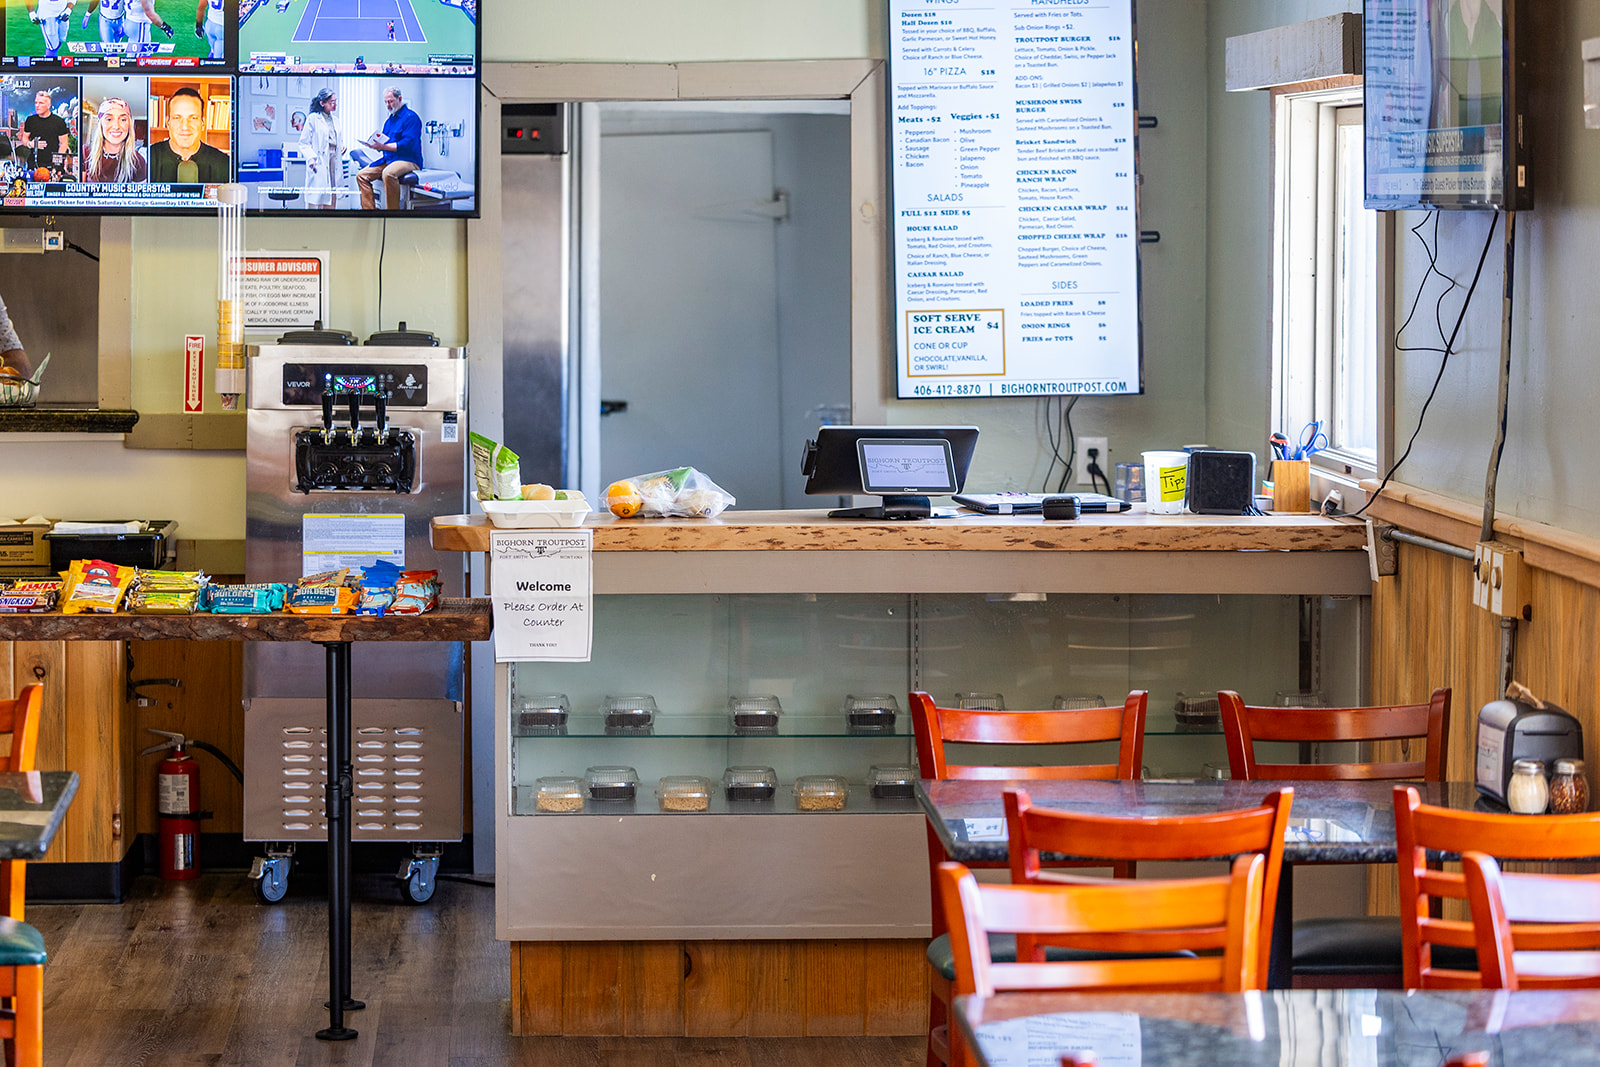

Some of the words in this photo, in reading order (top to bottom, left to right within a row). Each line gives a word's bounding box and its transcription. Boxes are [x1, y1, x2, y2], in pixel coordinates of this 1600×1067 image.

[66, 184, 101, 192] COUNTRY
[102, 184, 125, 192] MUSIC
[127, 184, 171, 193] SUPERSTAR
[928, 193, 963, 202] SALADS
[231, 262, 275, 271] SUMER
[277, 262, 317, 271] ADVISORY
[1052, 281, 1078, 289] SIDES
[914, 385, 981, 395] 406-412-8870
[1002, 382, 1127, 394] BIGHORNTROUTPOST.COM
[1160, 475, 1185, 489] Tips
[516, 581, 571, 591] Welcome
[504, 602, 535, 611] Please
[538, 602, 567, 611] Order
[570, 602, 584, 611] At
[523, 618, 564, 626] Counter
